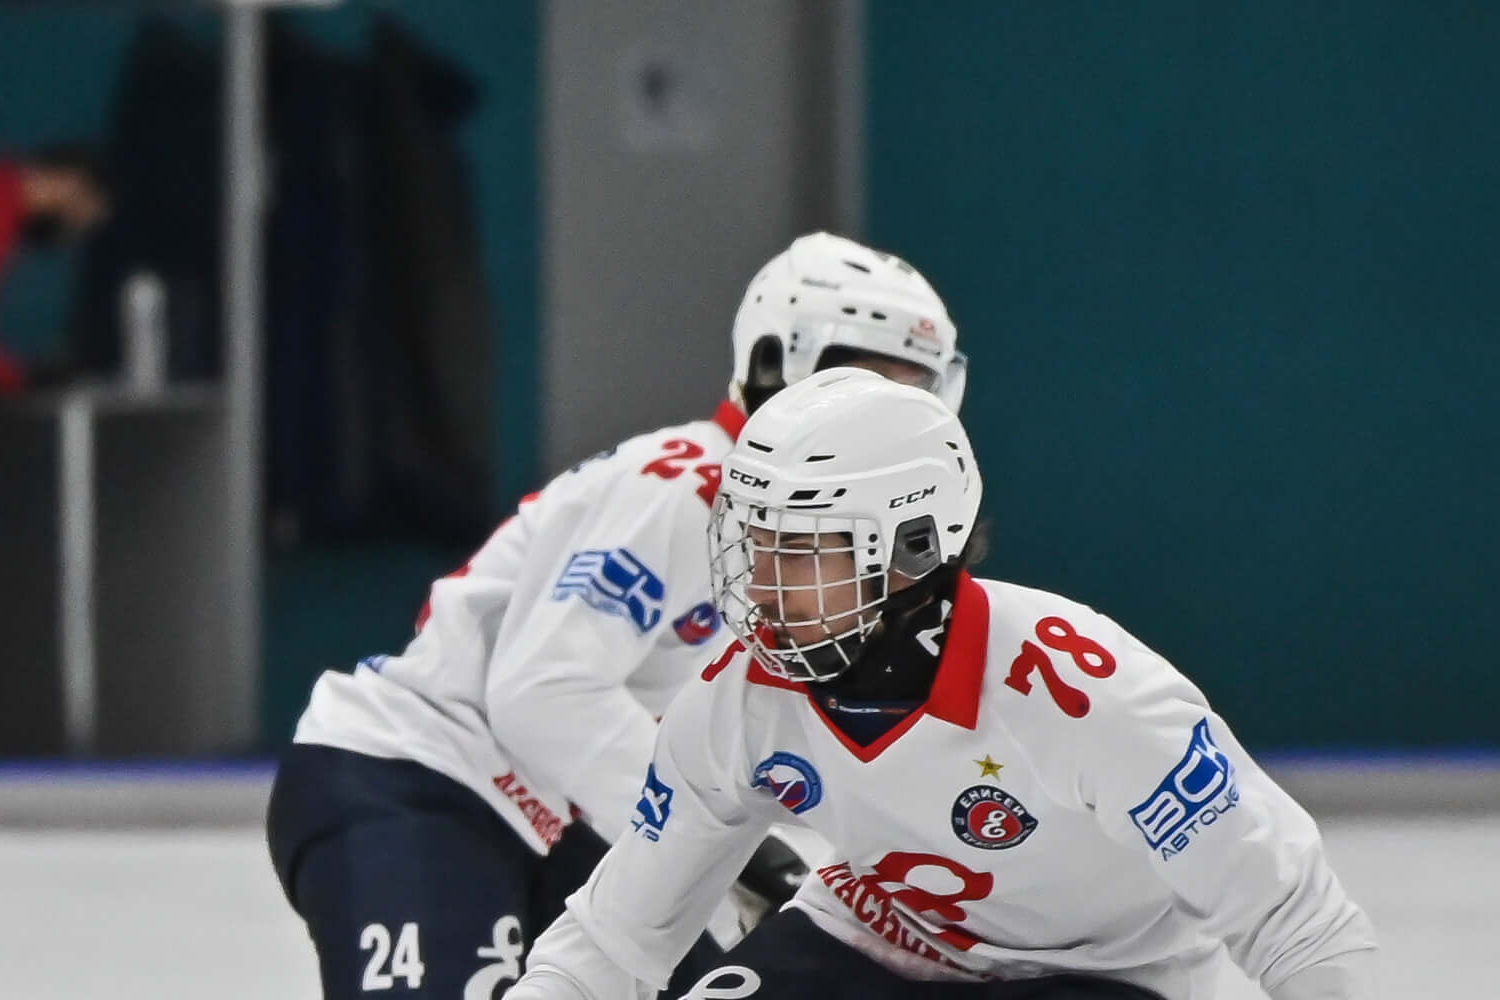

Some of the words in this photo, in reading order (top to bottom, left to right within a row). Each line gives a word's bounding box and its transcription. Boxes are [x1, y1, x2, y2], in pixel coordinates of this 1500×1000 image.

[729, 468, 771, 490] CCM
[888, 485, 937, 509] CCM
[1003, 616, 1117, 719] 78
[359, 921, 426, 992] 24
